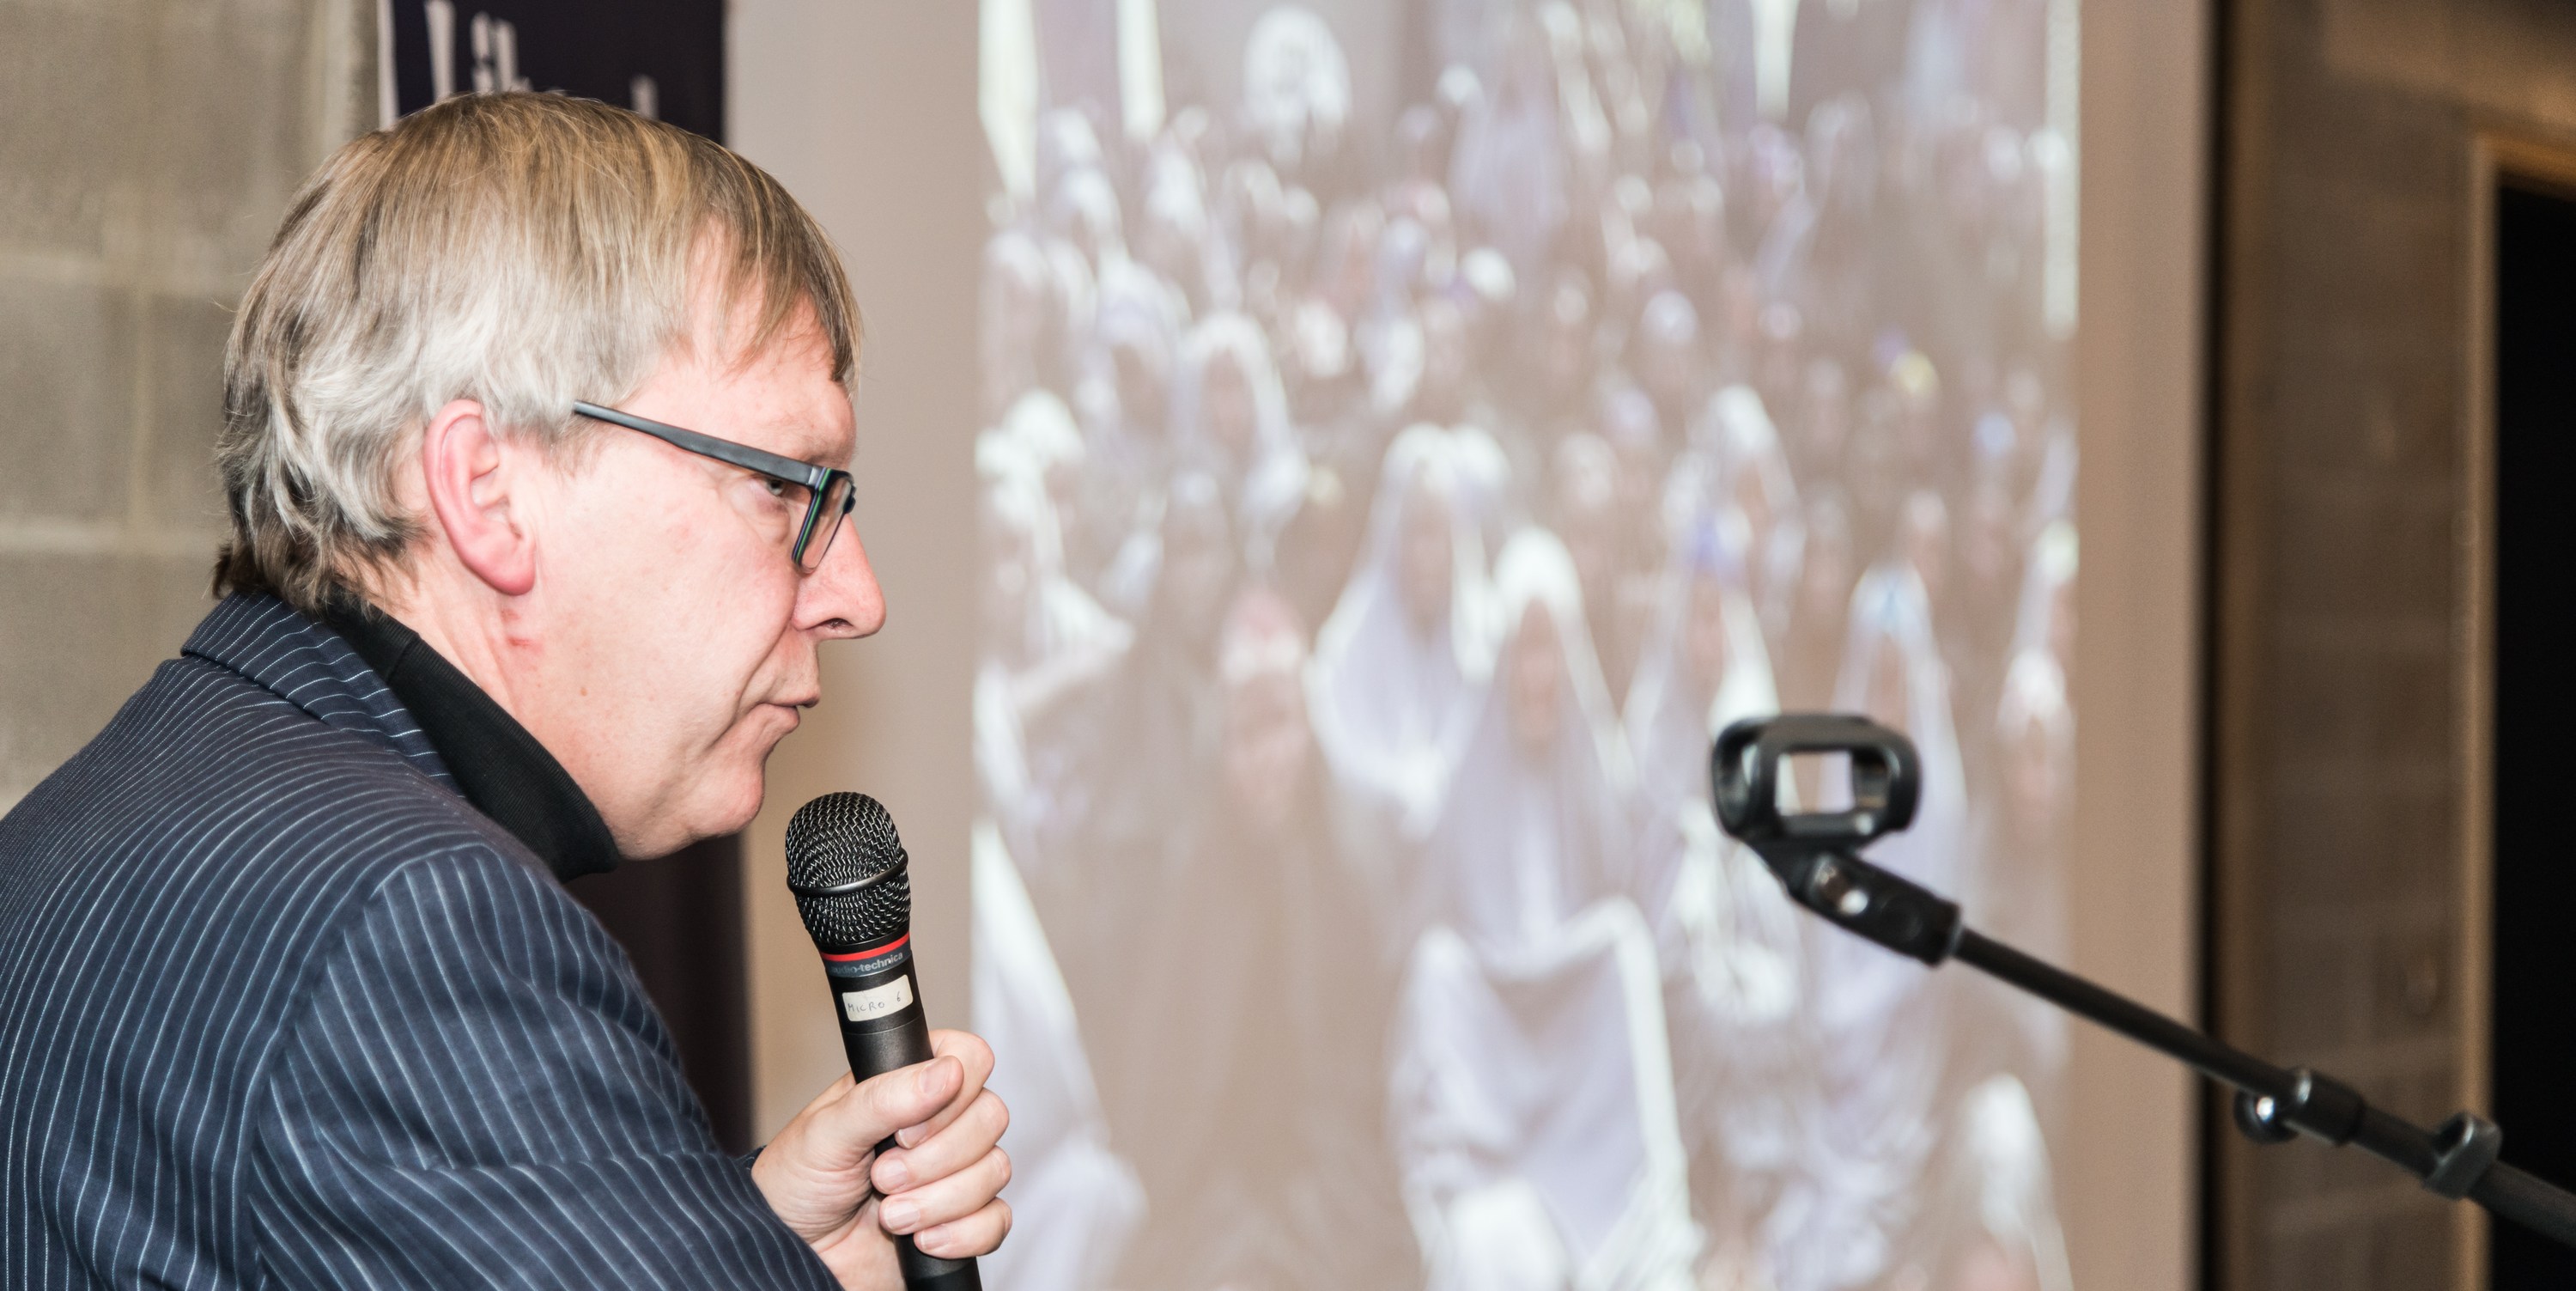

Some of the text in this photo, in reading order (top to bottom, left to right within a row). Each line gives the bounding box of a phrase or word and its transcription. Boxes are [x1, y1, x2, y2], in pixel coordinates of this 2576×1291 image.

[831, 952, 903, 973] audio-technica
[848, 990, 902, 1013] MICRO 6
